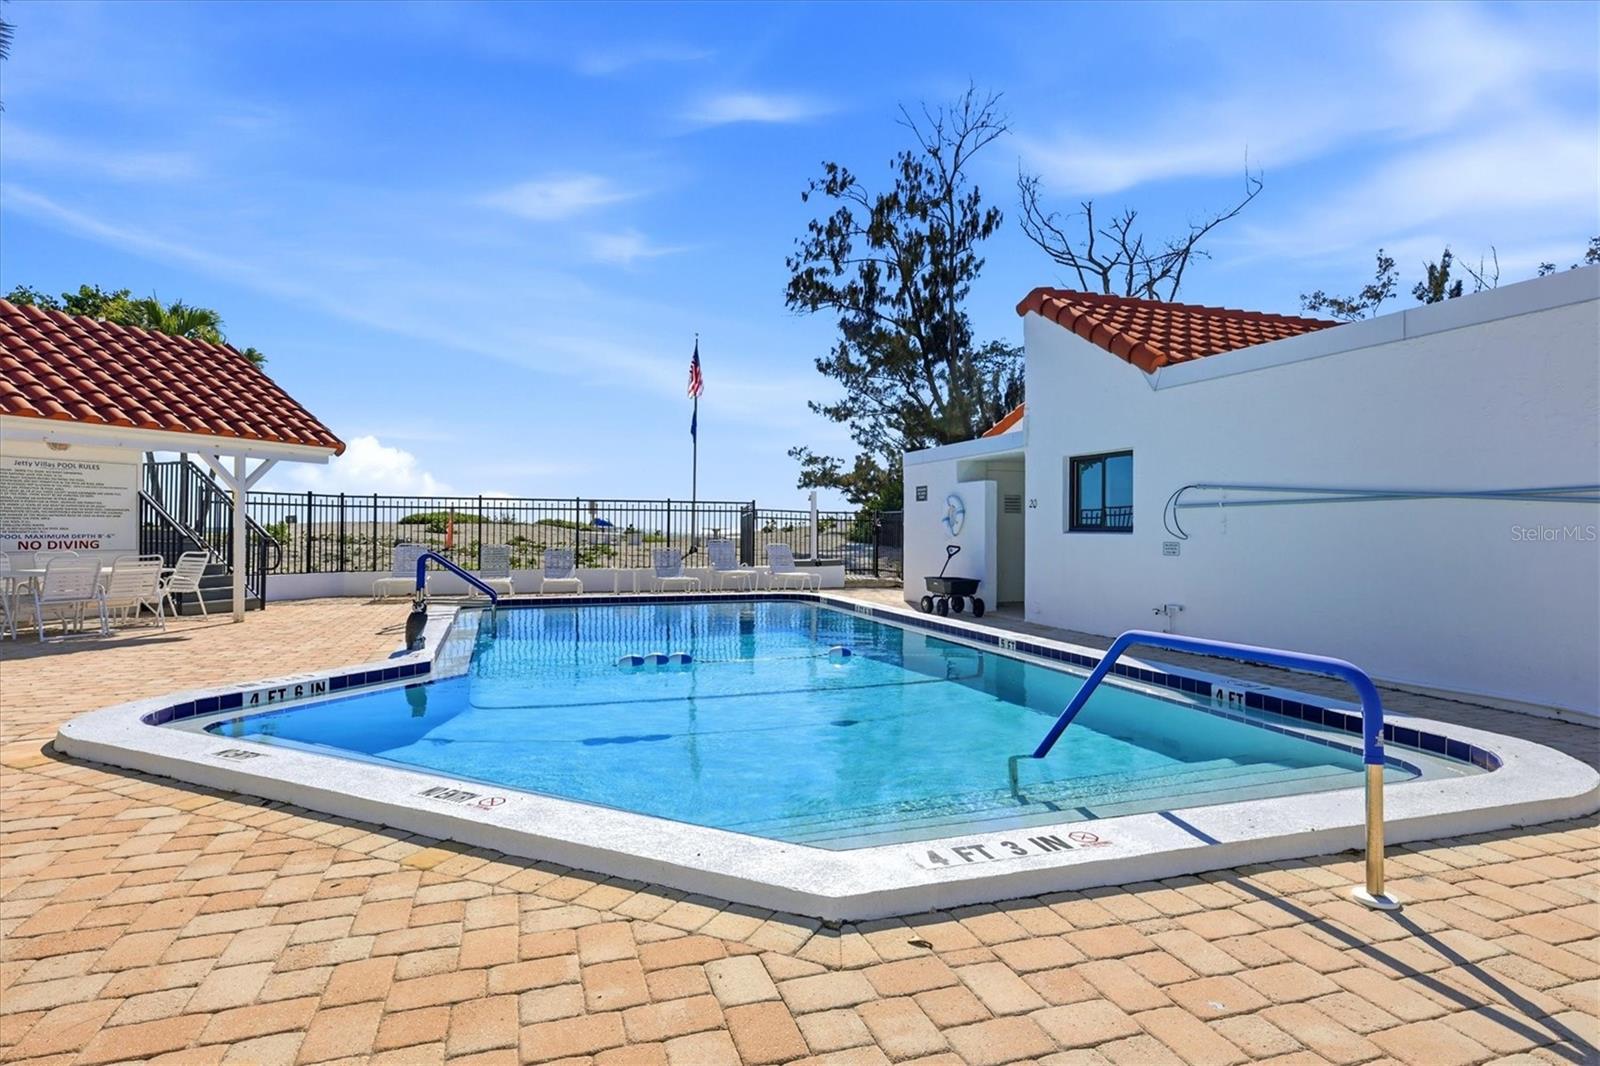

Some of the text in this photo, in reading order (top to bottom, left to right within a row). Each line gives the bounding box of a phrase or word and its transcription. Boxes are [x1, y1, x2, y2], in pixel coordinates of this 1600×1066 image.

[17, 540, 100, 550] NO DIVING
[249, 692, 260, 705] 4
[267, 687, 287, 704] FT
[310, 681, 326, 694] IN
[1215, 688, 1244, 704] 4 FT
[927, 850, 949, 867] 4
[951, 844, 994, 863] FT
[1001, 840, 1028, 856] 3
[1028, 835, 1074, 853] IN
